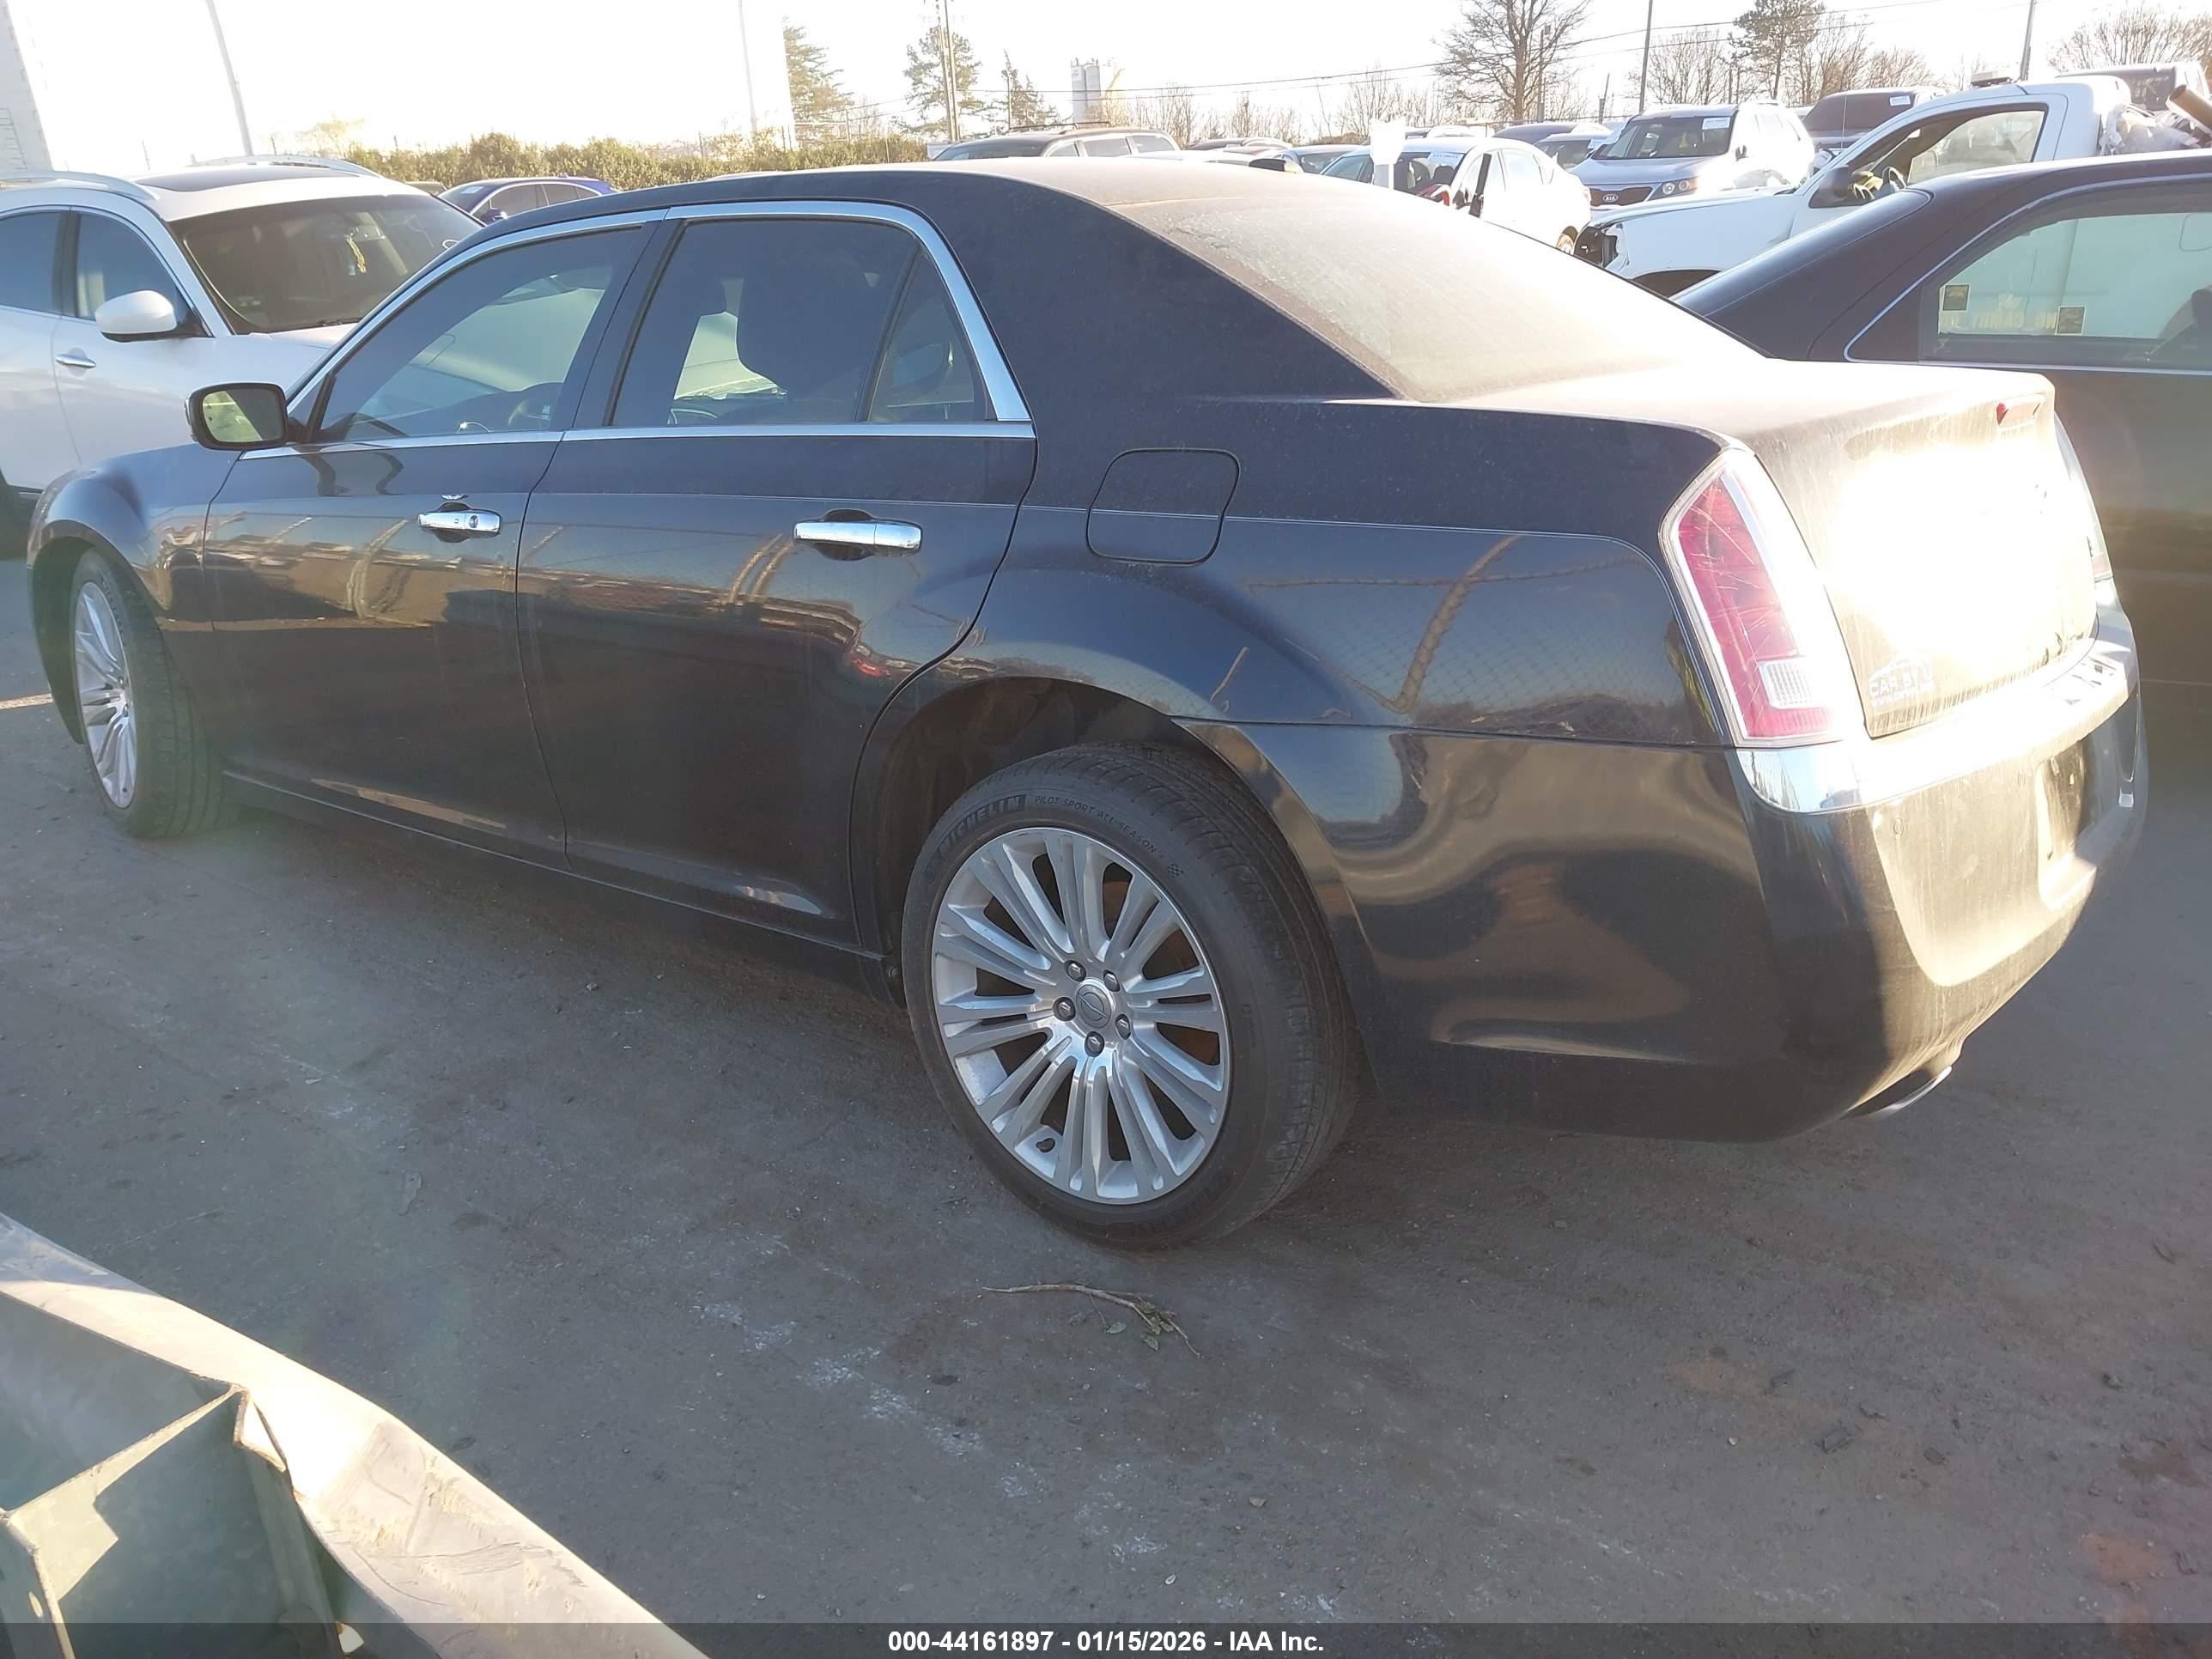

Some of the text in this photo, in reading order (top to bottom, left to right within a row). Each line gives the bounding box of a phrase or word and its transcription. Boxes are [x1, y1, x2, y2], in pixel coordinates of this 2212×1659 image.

[937, 795, 1158, 858] MICHELIN PILOT SPORT ALL SEASON
